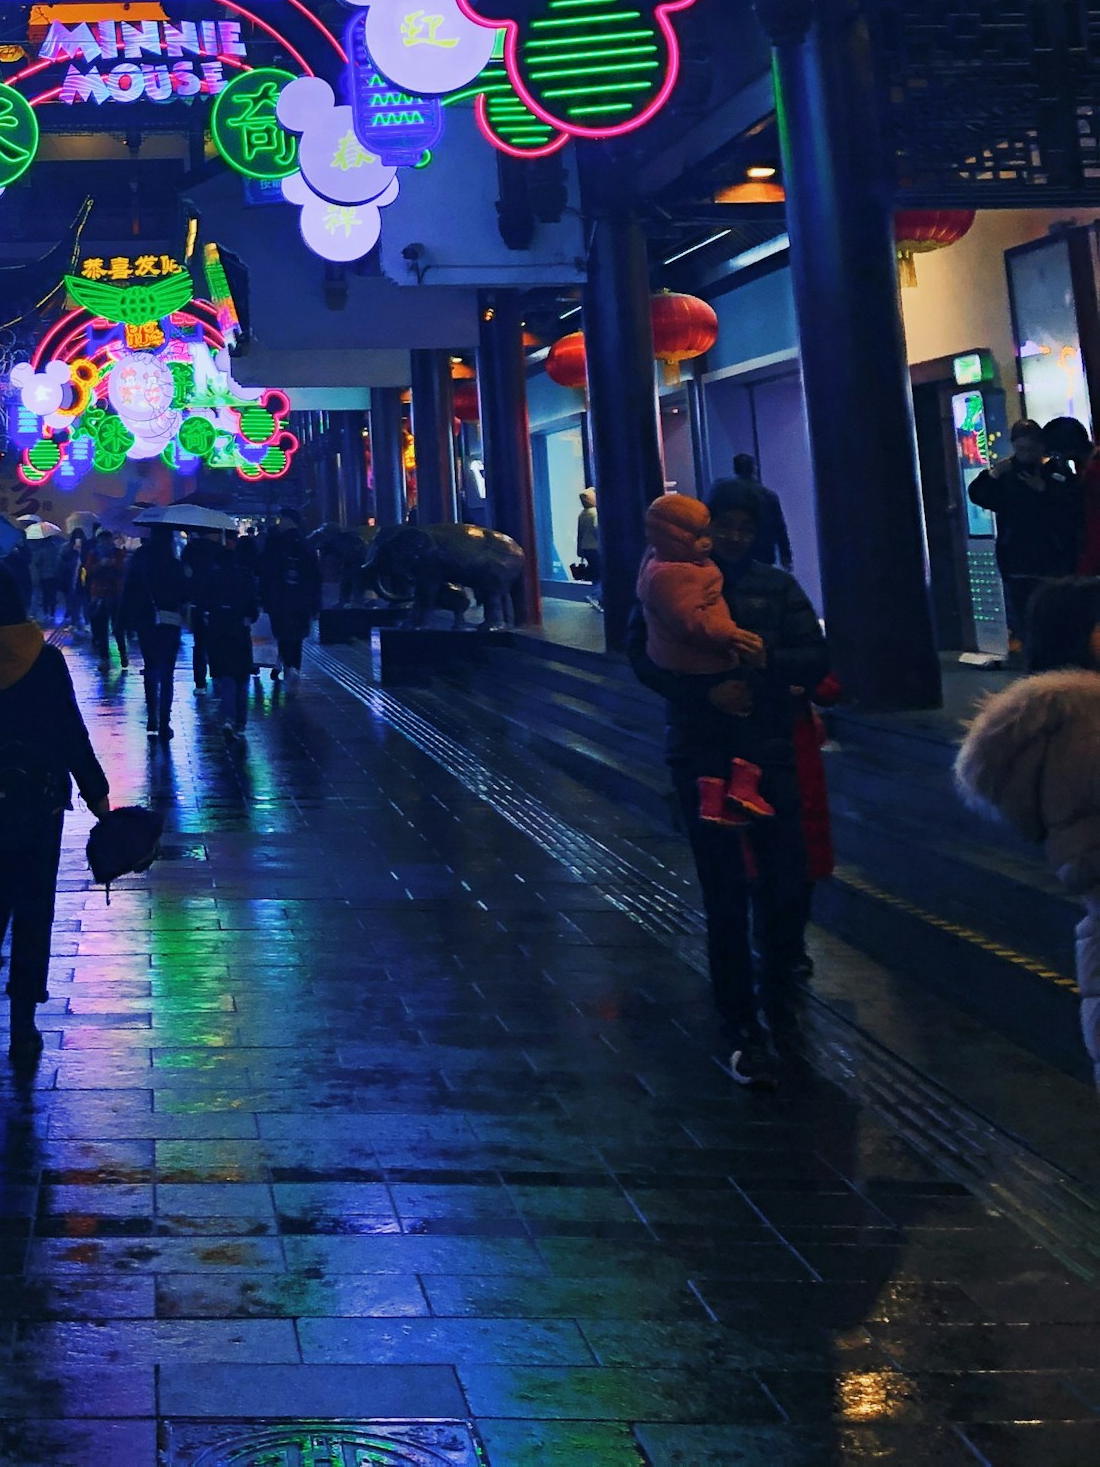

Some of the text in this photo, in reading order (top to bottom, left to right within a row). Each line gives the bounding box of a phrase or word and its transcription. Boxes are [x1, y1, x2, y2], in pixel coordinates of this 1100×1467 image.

[38, 19, 247, 64] MINNIE
[58, 60, 228, 105] MOUSE
[227, 82, 296, 164] 奇
[331, 129, 377, 171] 春
[81, 255, 182, 280] 恭喜发财
